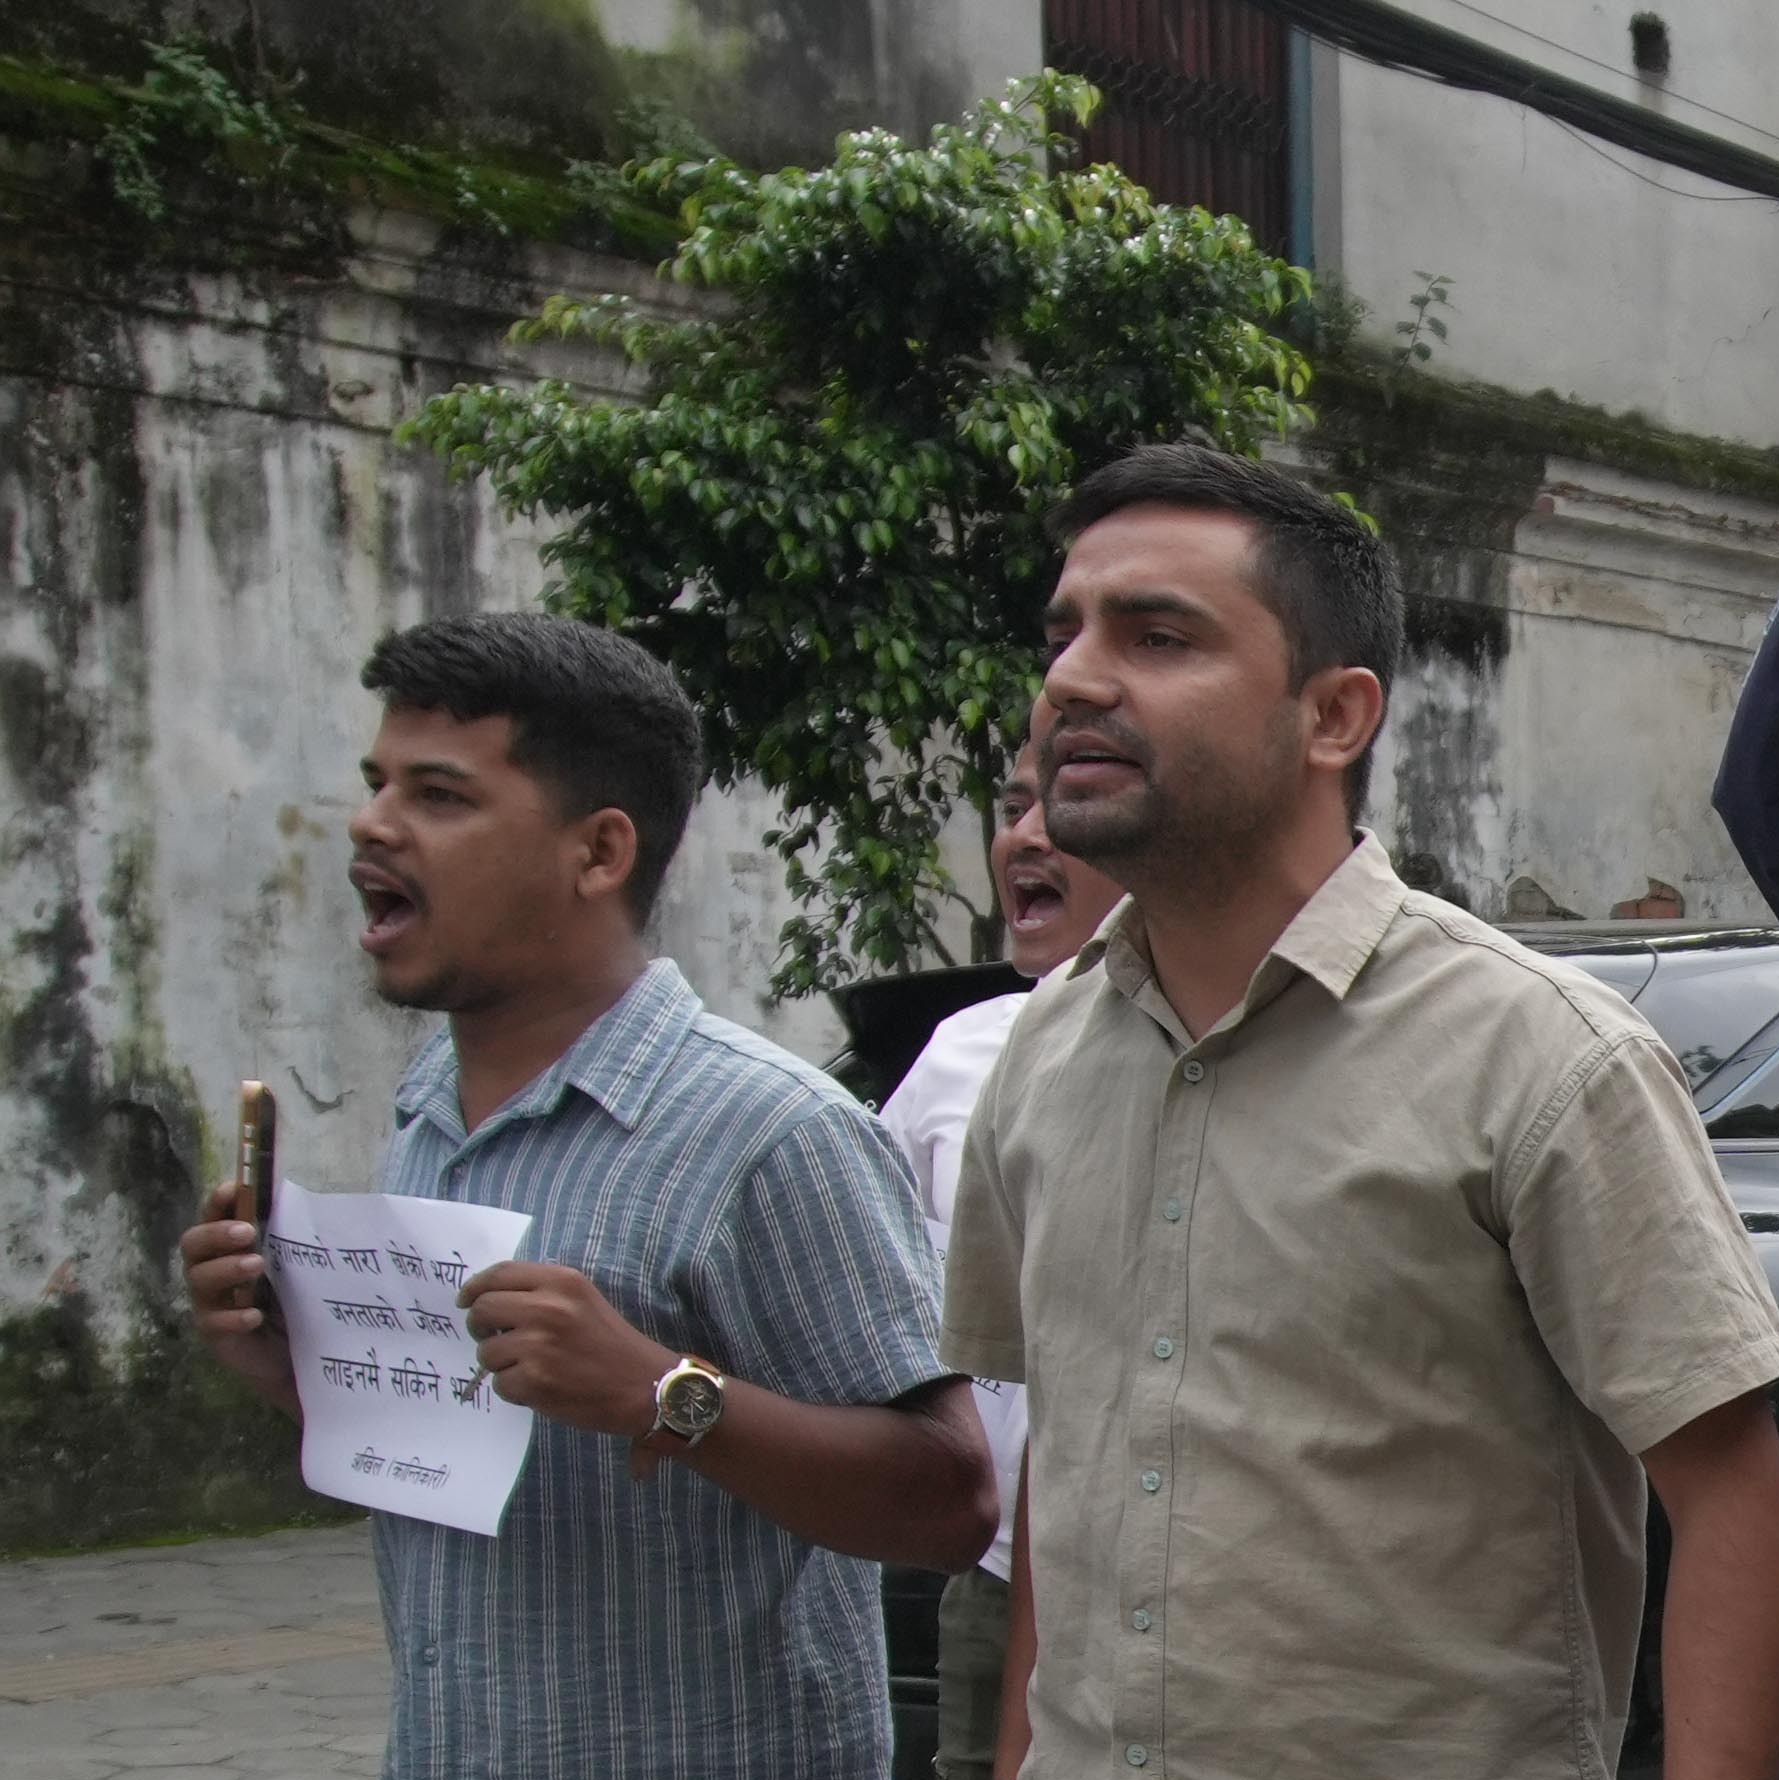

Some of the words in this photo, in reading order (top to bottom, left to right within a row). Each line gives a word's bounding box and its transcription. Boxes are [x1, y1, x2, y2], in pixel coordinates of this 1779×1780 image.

[337, 1248, 382, 1275] नारा
[323, 1295, 404, 1332] जनताको
[320, 1347, 382, 1393] लाइनमै
[388, 1357, 441, 1402] सकिने
[352, 1446, 386, 1475] अखिल
